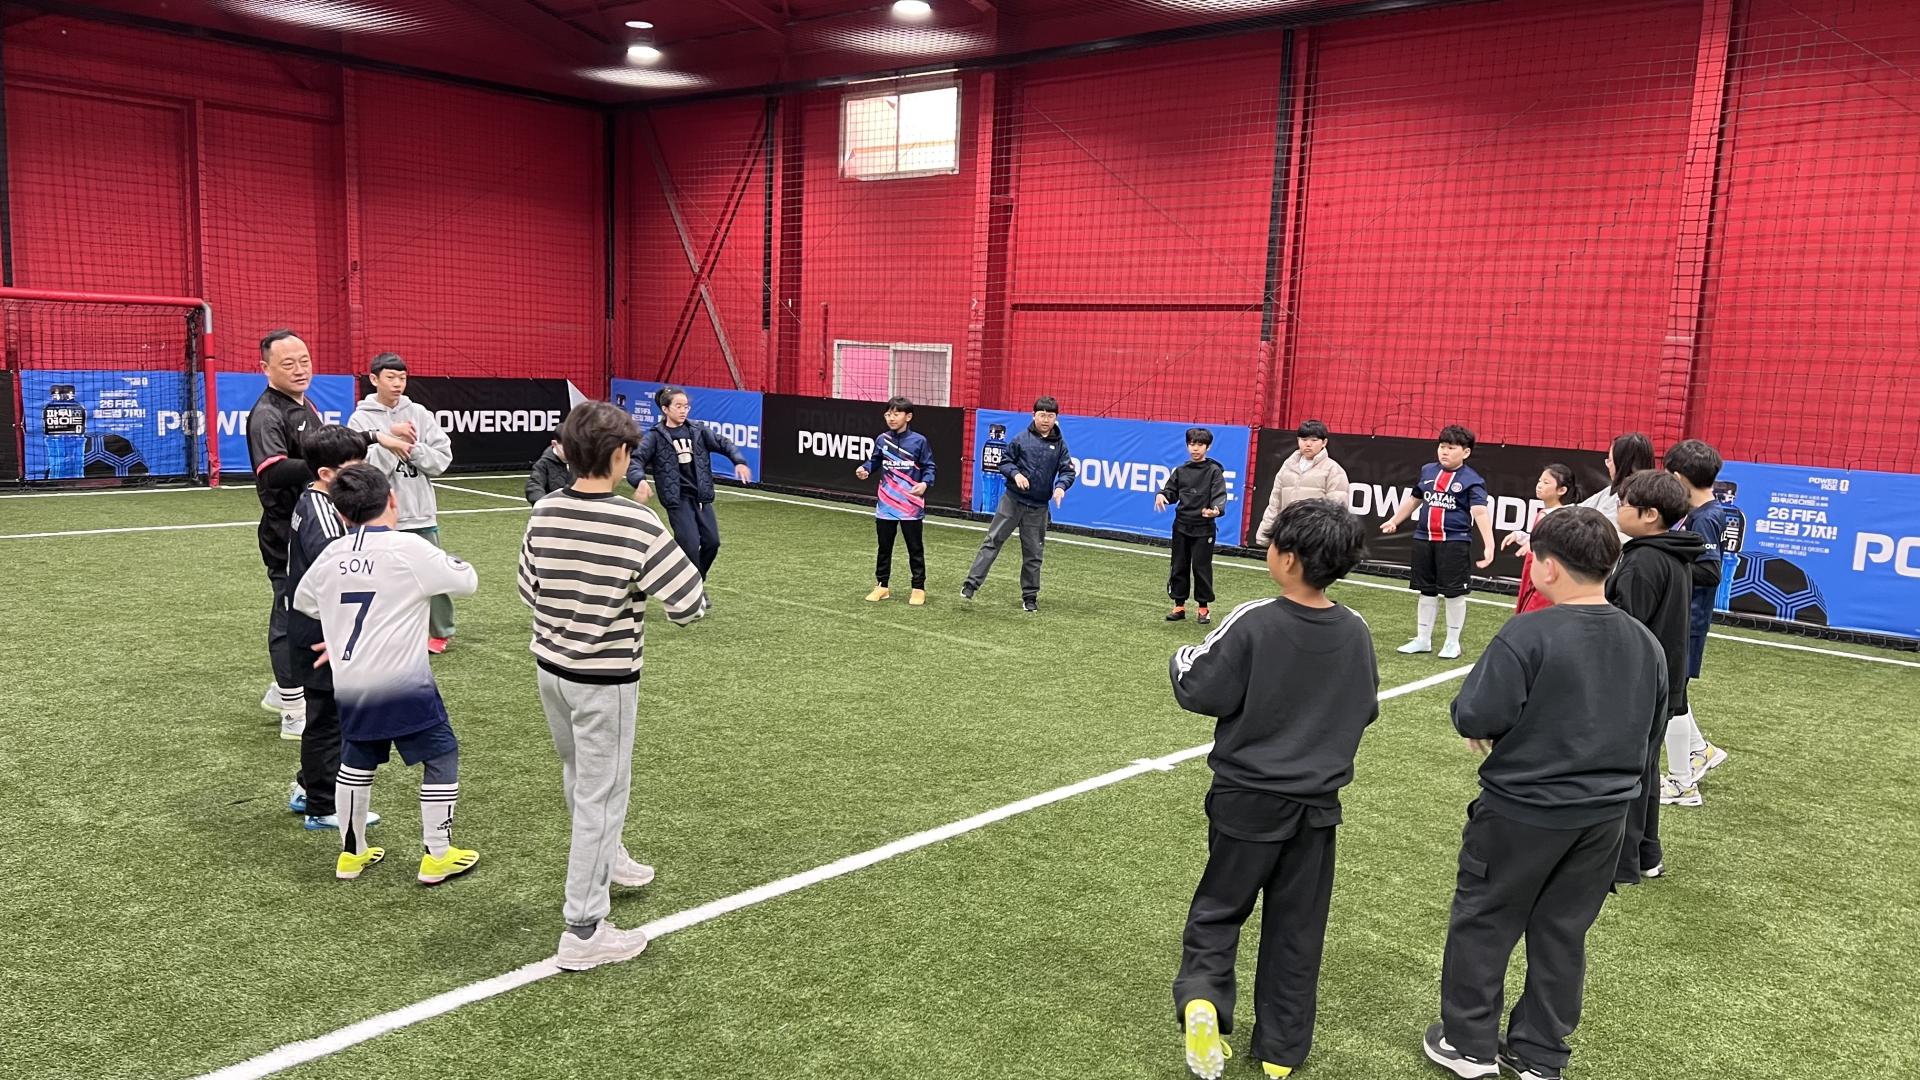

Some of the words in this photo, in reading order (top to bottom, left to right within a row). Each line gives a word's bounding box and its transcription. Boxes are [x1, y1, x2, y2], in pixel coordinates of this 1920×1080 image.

[115, 399, 139, 408] FIFA
[430, 410, 561, 433] OWERADE
[798, 430, 875, 461] POWER
[1808, 477, 1838, 486] POWER
[1423, 491, 1456, 503] QATAR
[1767, 507, 1790, 520] 26
[1791, 509, 1828, 524] FIFA
[1755, 519, 1800, 536] 월드컵
[1801, 524, 1838, 540] 가자!
[339, 558, 375, 576] SON
[340, 591, 377, 661] 7
